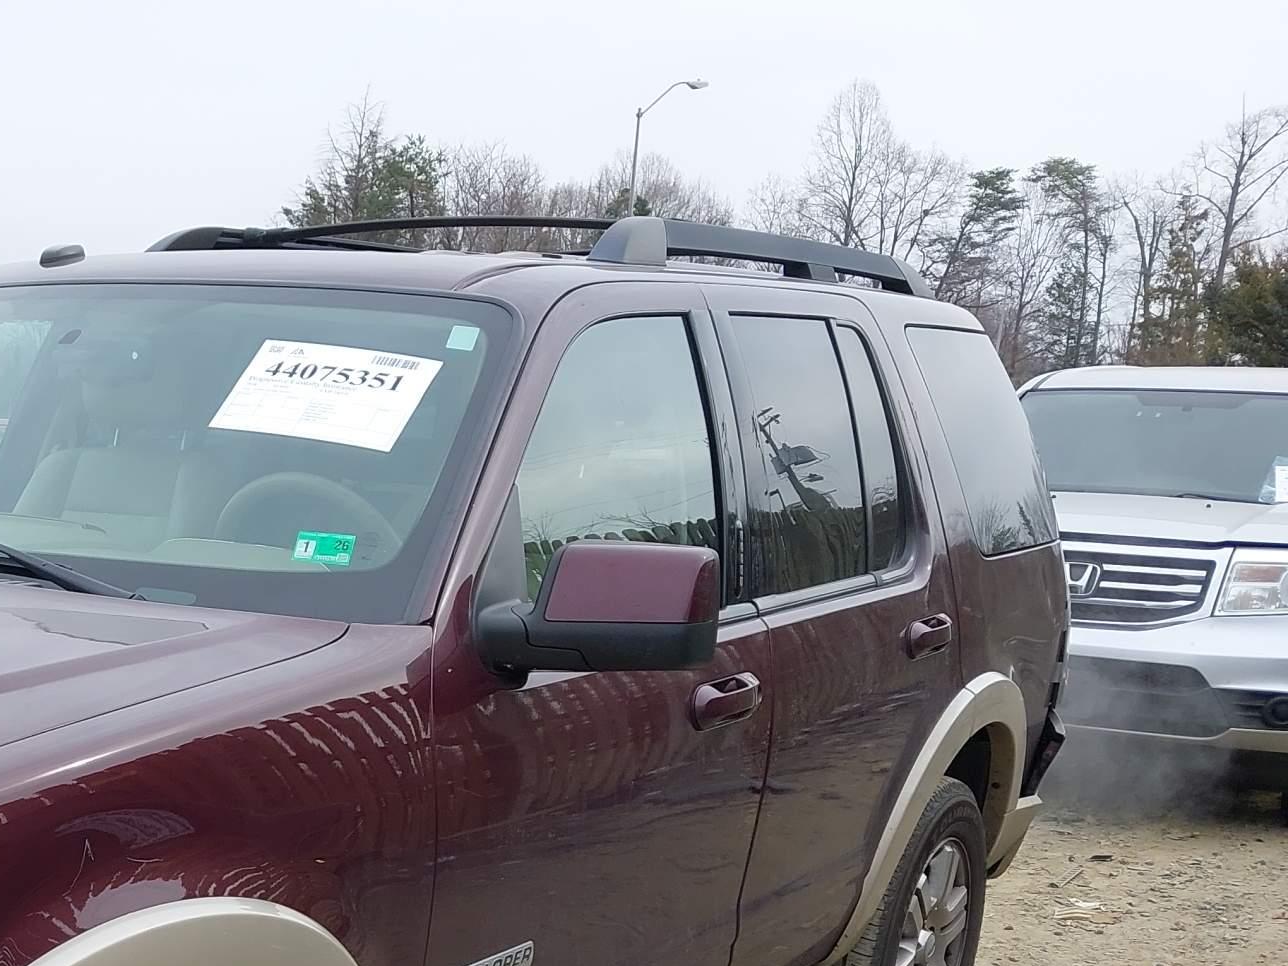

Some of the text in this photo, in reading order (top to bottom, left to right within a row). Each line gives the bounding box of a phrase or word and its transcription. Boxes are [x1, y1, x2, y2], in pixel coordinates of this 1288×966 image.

[265, 360, 405, 392] 44075351
[303, 539, 351, 553] 1 26
